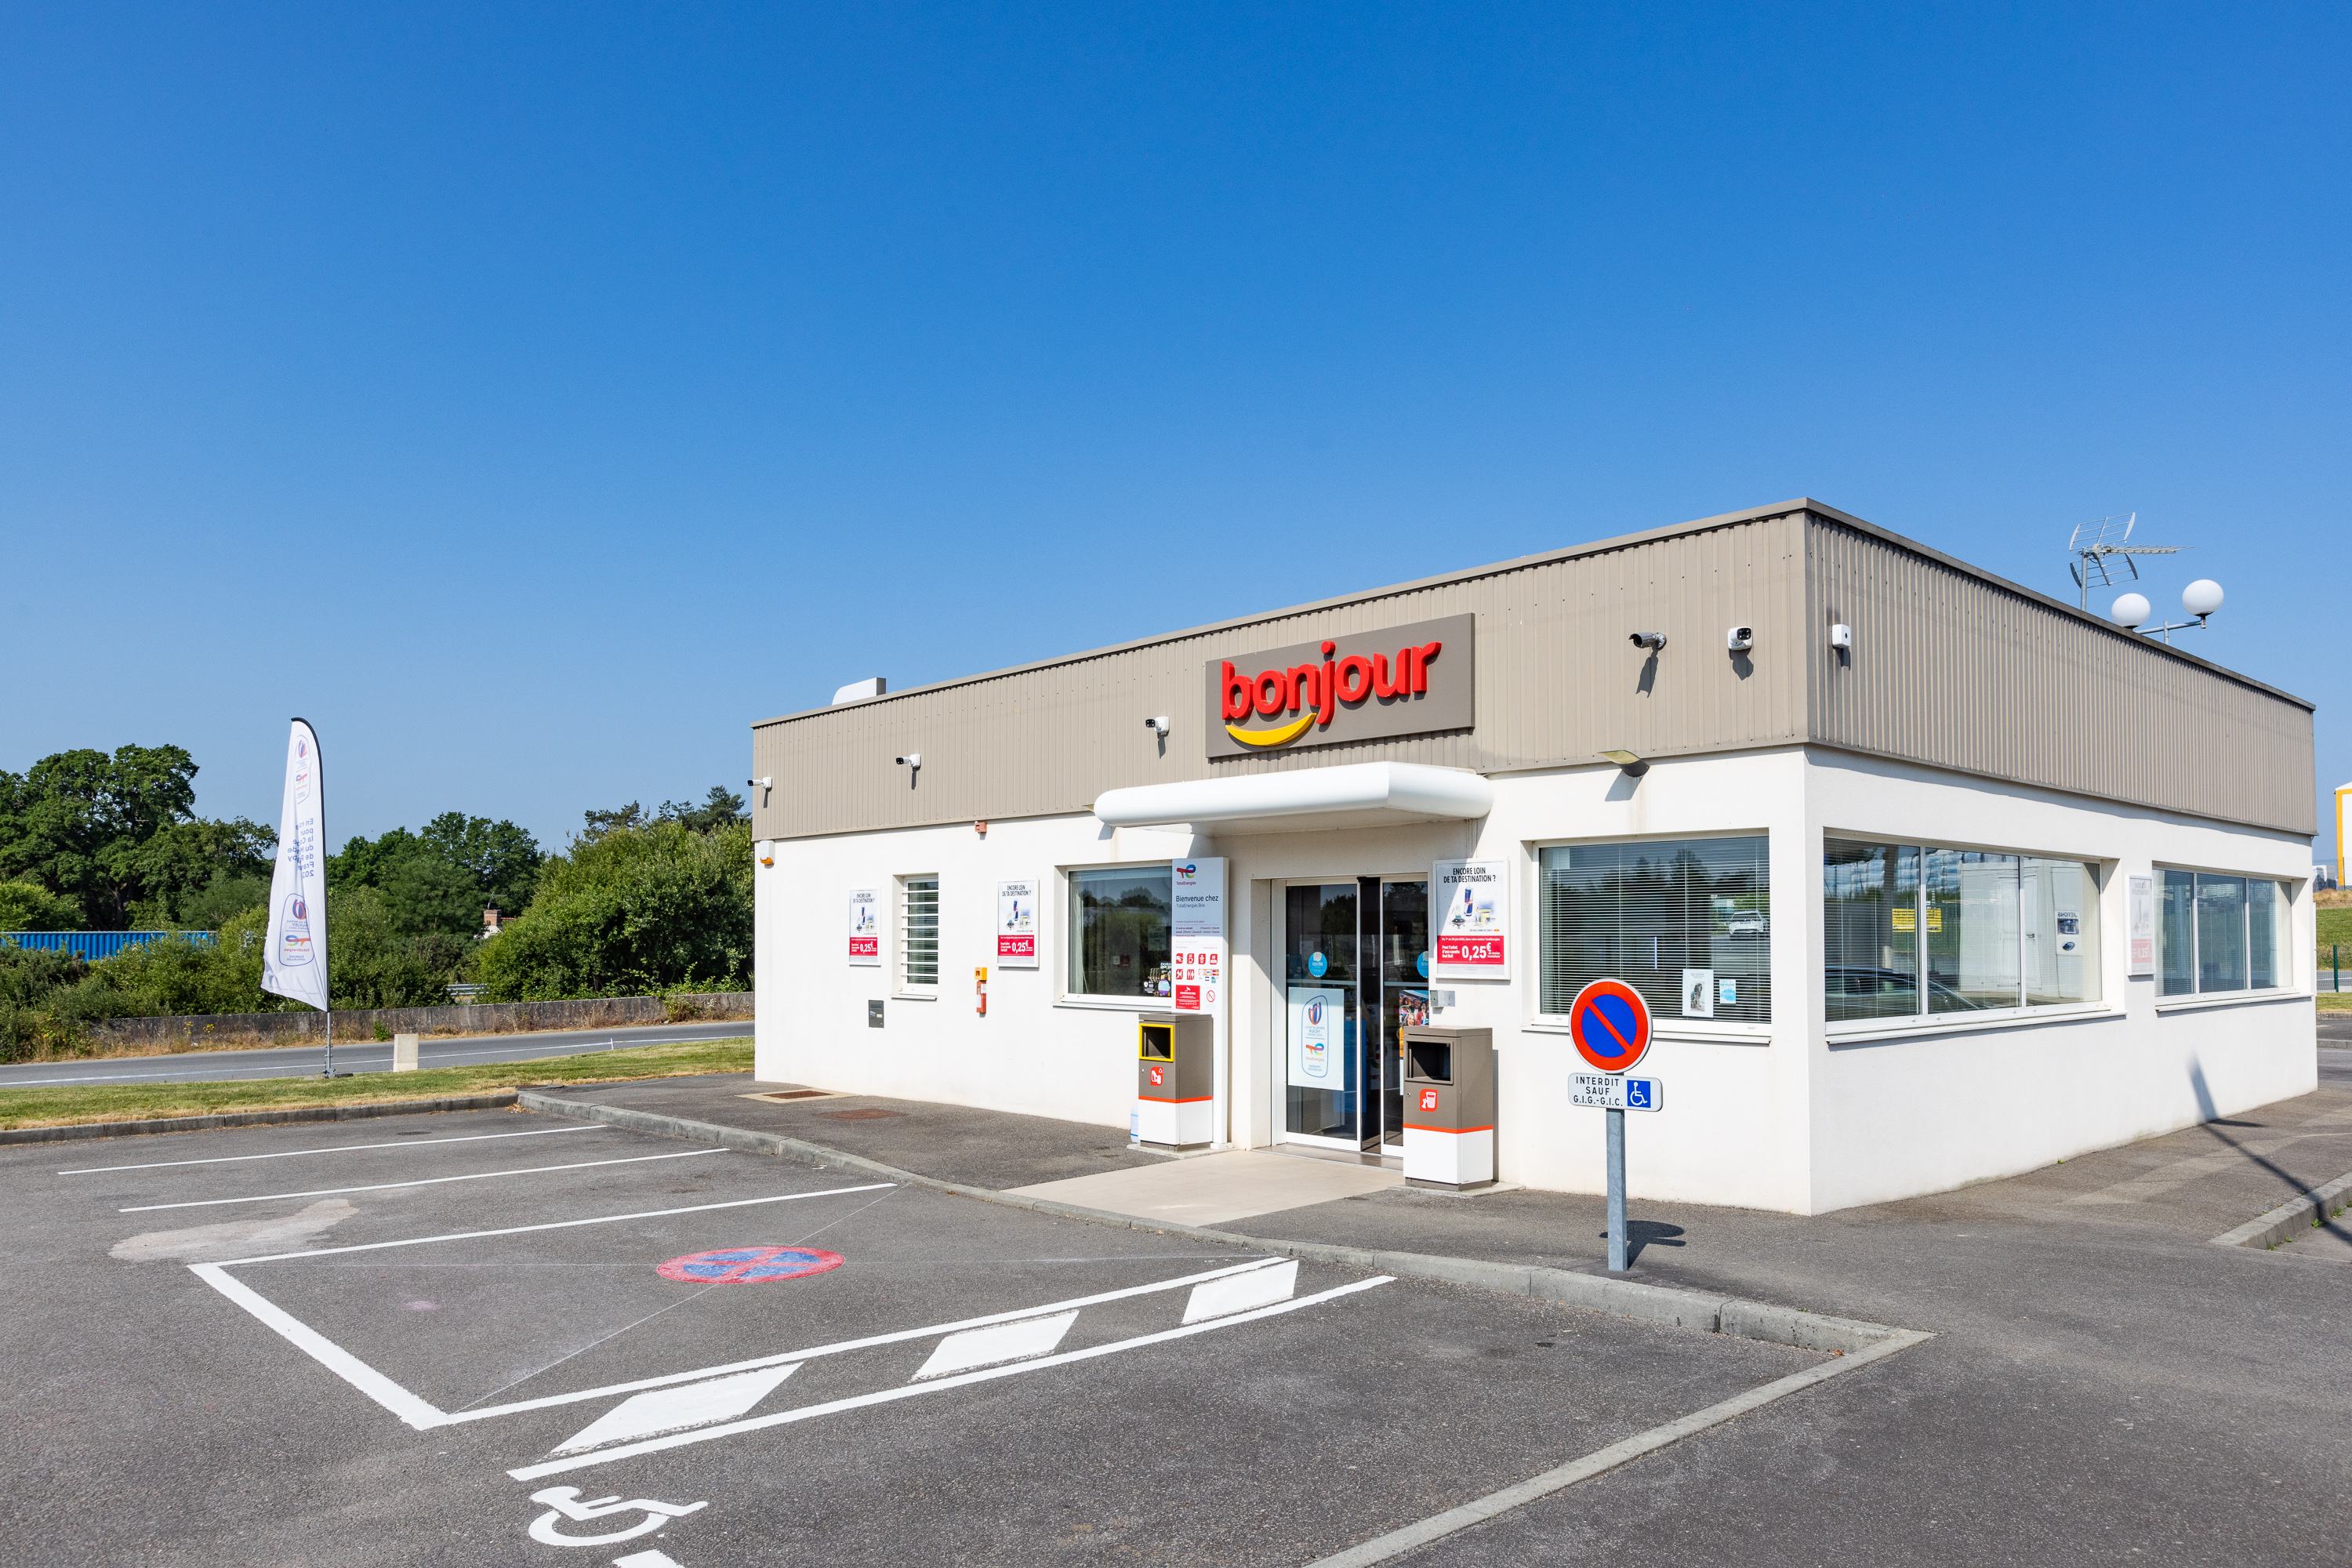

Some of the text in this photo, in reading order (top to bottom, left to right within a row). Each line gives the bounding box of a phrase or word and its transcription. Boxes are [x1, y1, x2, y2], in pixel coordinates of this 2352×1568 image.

[1221, 641, 1442, 724] bonjour
[1576, 1076, 1620, 1087] INTERDIT
[1585, 1087, 1610, 1095] SAUF
[1573, 1095, 1623, 1106] G.I.G.-G.I.C.
